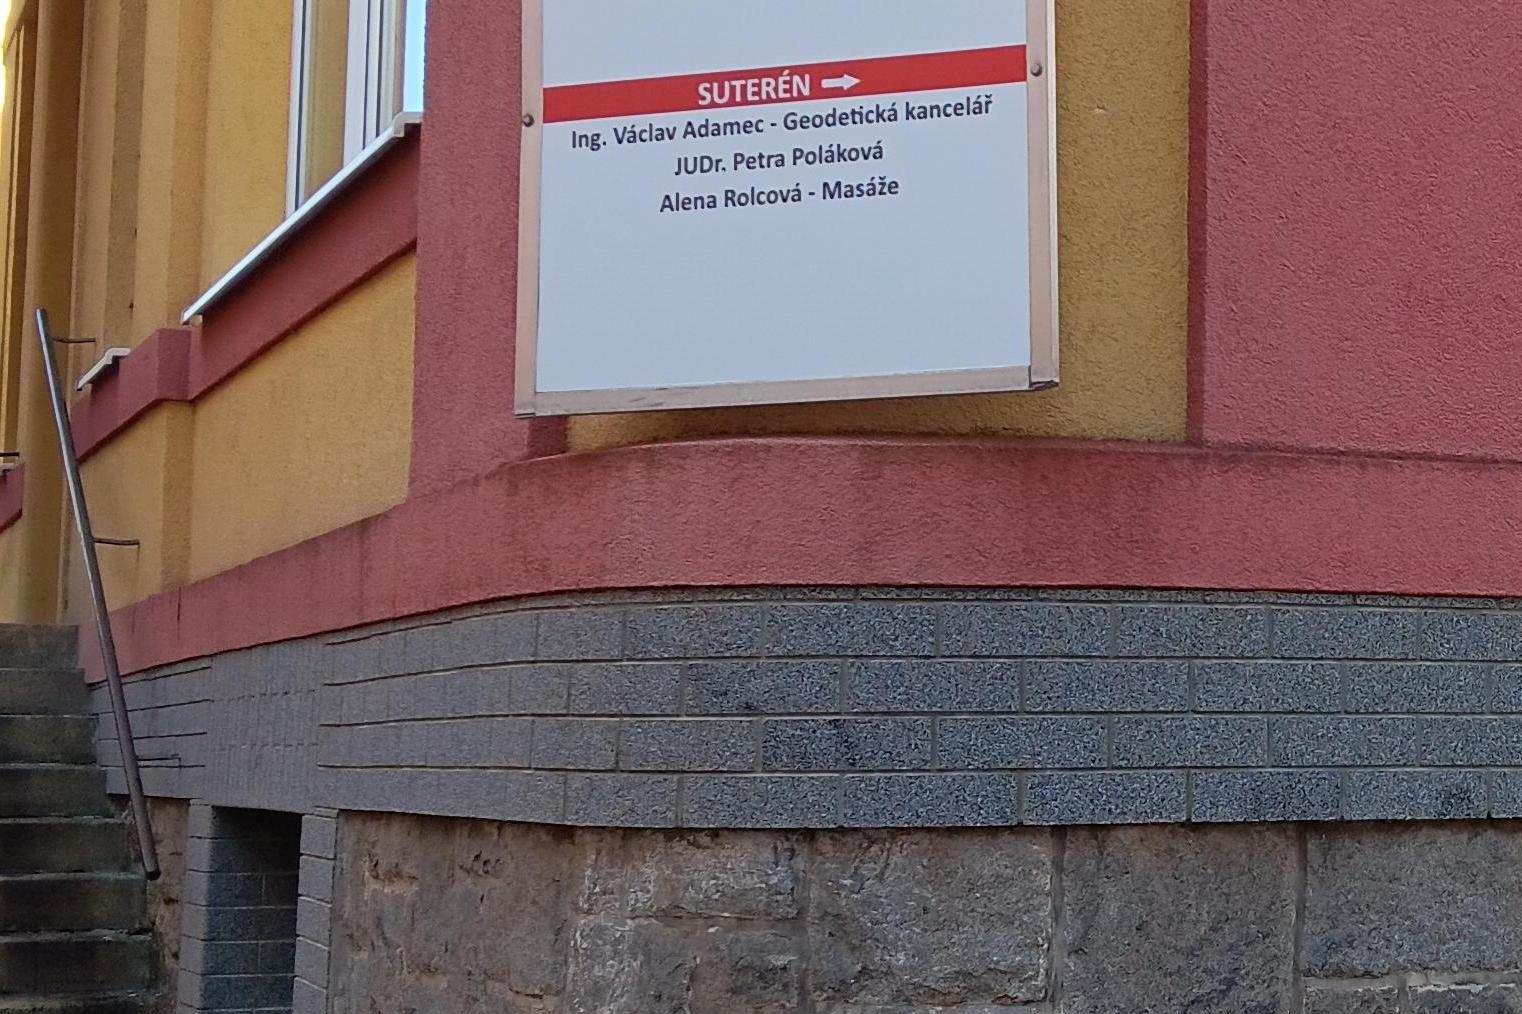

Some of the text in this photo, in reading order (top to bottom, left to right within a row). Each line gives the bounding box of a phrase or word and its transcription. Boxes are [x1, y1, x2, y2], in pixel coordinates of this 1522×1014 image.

[697, 70, 811, 106] SUTERÉN
[571, 130, 608, 152] Ing.
[613, 124, 677, 146] Václav
[682, 117, 765, 141] Adamec
[783, 101, 899, 132] Geodetická
[905, 94, 994, 121] kancelář
[674, 140, 885, 177] JUDr. Petra Poláková
[659, 189, 718, 213] Alena
[724, 182, 803, 209] Rolcová
[822, 175, 900, 202] Masáže
